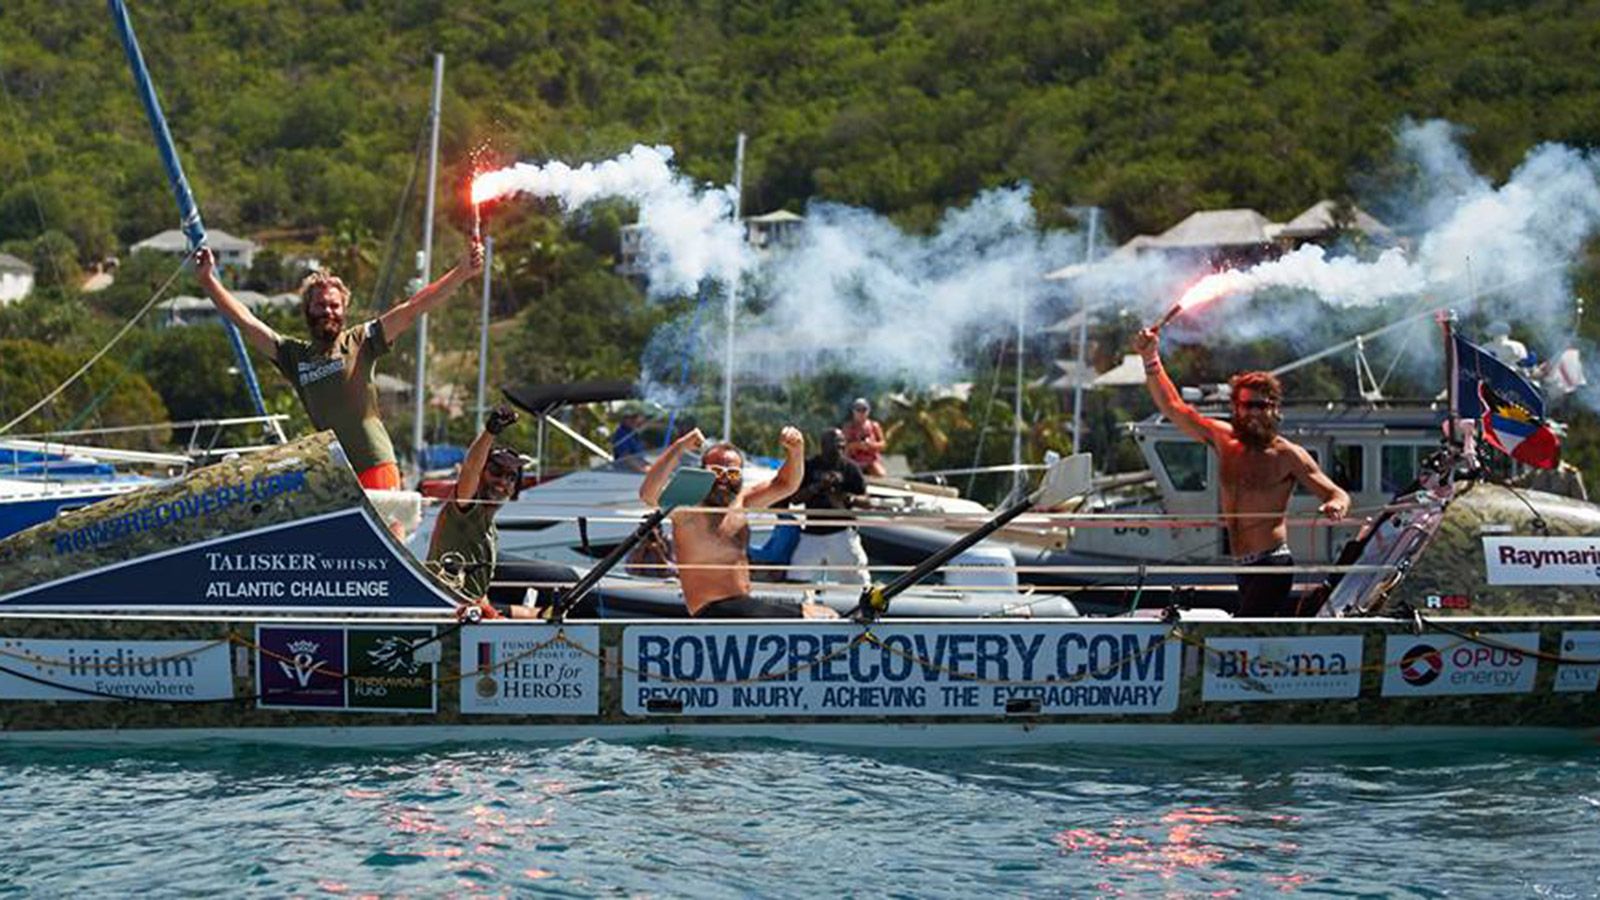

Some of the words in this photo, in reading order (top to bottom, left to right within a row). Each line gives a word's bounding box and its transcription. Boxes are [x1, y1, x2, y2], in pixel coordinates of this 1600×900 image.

[205, 552, 317, 571] TALISKER
[320, 558, 389, 571] WHISKY
[205, 581, 285, 598] ATLANTIC
[290, 581, 390, 598] CHALLENGE
[68, 648, 196, 677] iridium
[637, 633, 1166, 683] ROW2RECOVERY.COM
[1215, 650, 1349, 679] Blesma
[1452, 648, 1524, 669] OPUS
[504, 661, 555, 679] HELP
[556, 662, 582, 683] for
[1451, 668, 1521, 686] energy
[95, 680, 195, 696] Everywhere
[504, 681, 583, 699] HEROES
[637, 687, 719, 708] BEYOND
[822, 686, 926, 708] ACHIEVING
[940, 686, 980, 707] THE
[992, 685, 1164, 707] EXTRAORDINARY
